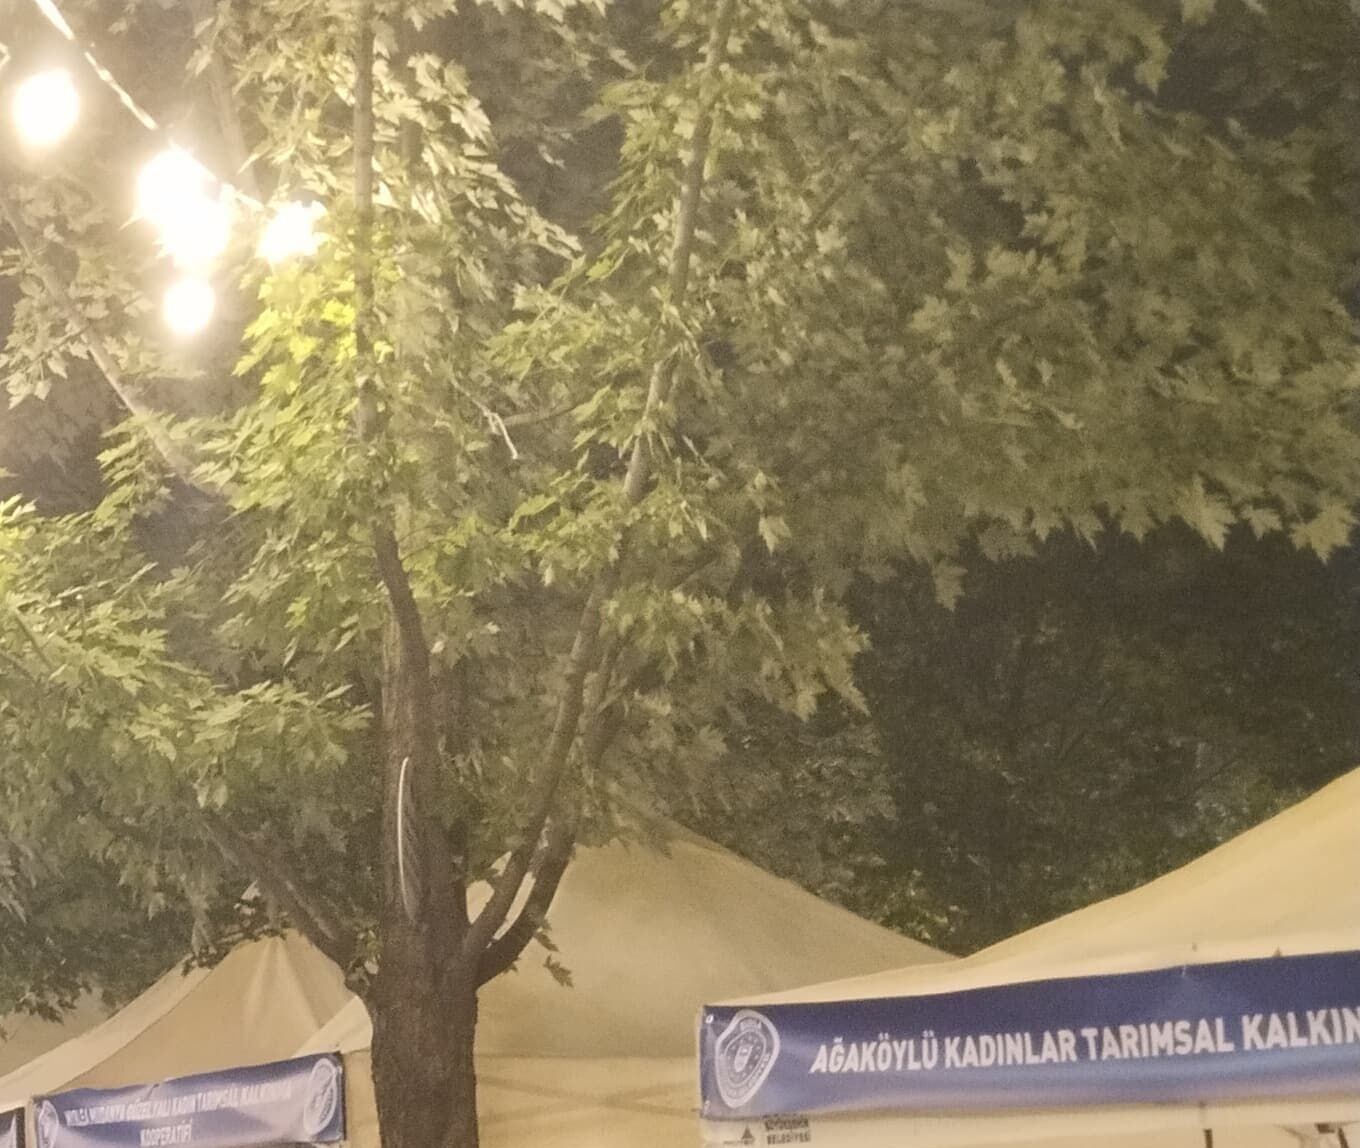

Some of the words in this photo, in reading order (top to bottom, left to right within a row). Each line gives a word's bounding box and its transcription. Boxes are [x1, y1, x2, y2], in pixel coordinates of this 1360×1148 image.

[808, 1030, 938, 1074] AĞAKÖYLÜ
[943, 1027, 1078, 1069] KADINLAR
[1081, 1017, 1235, 1061] TARIMSAL
